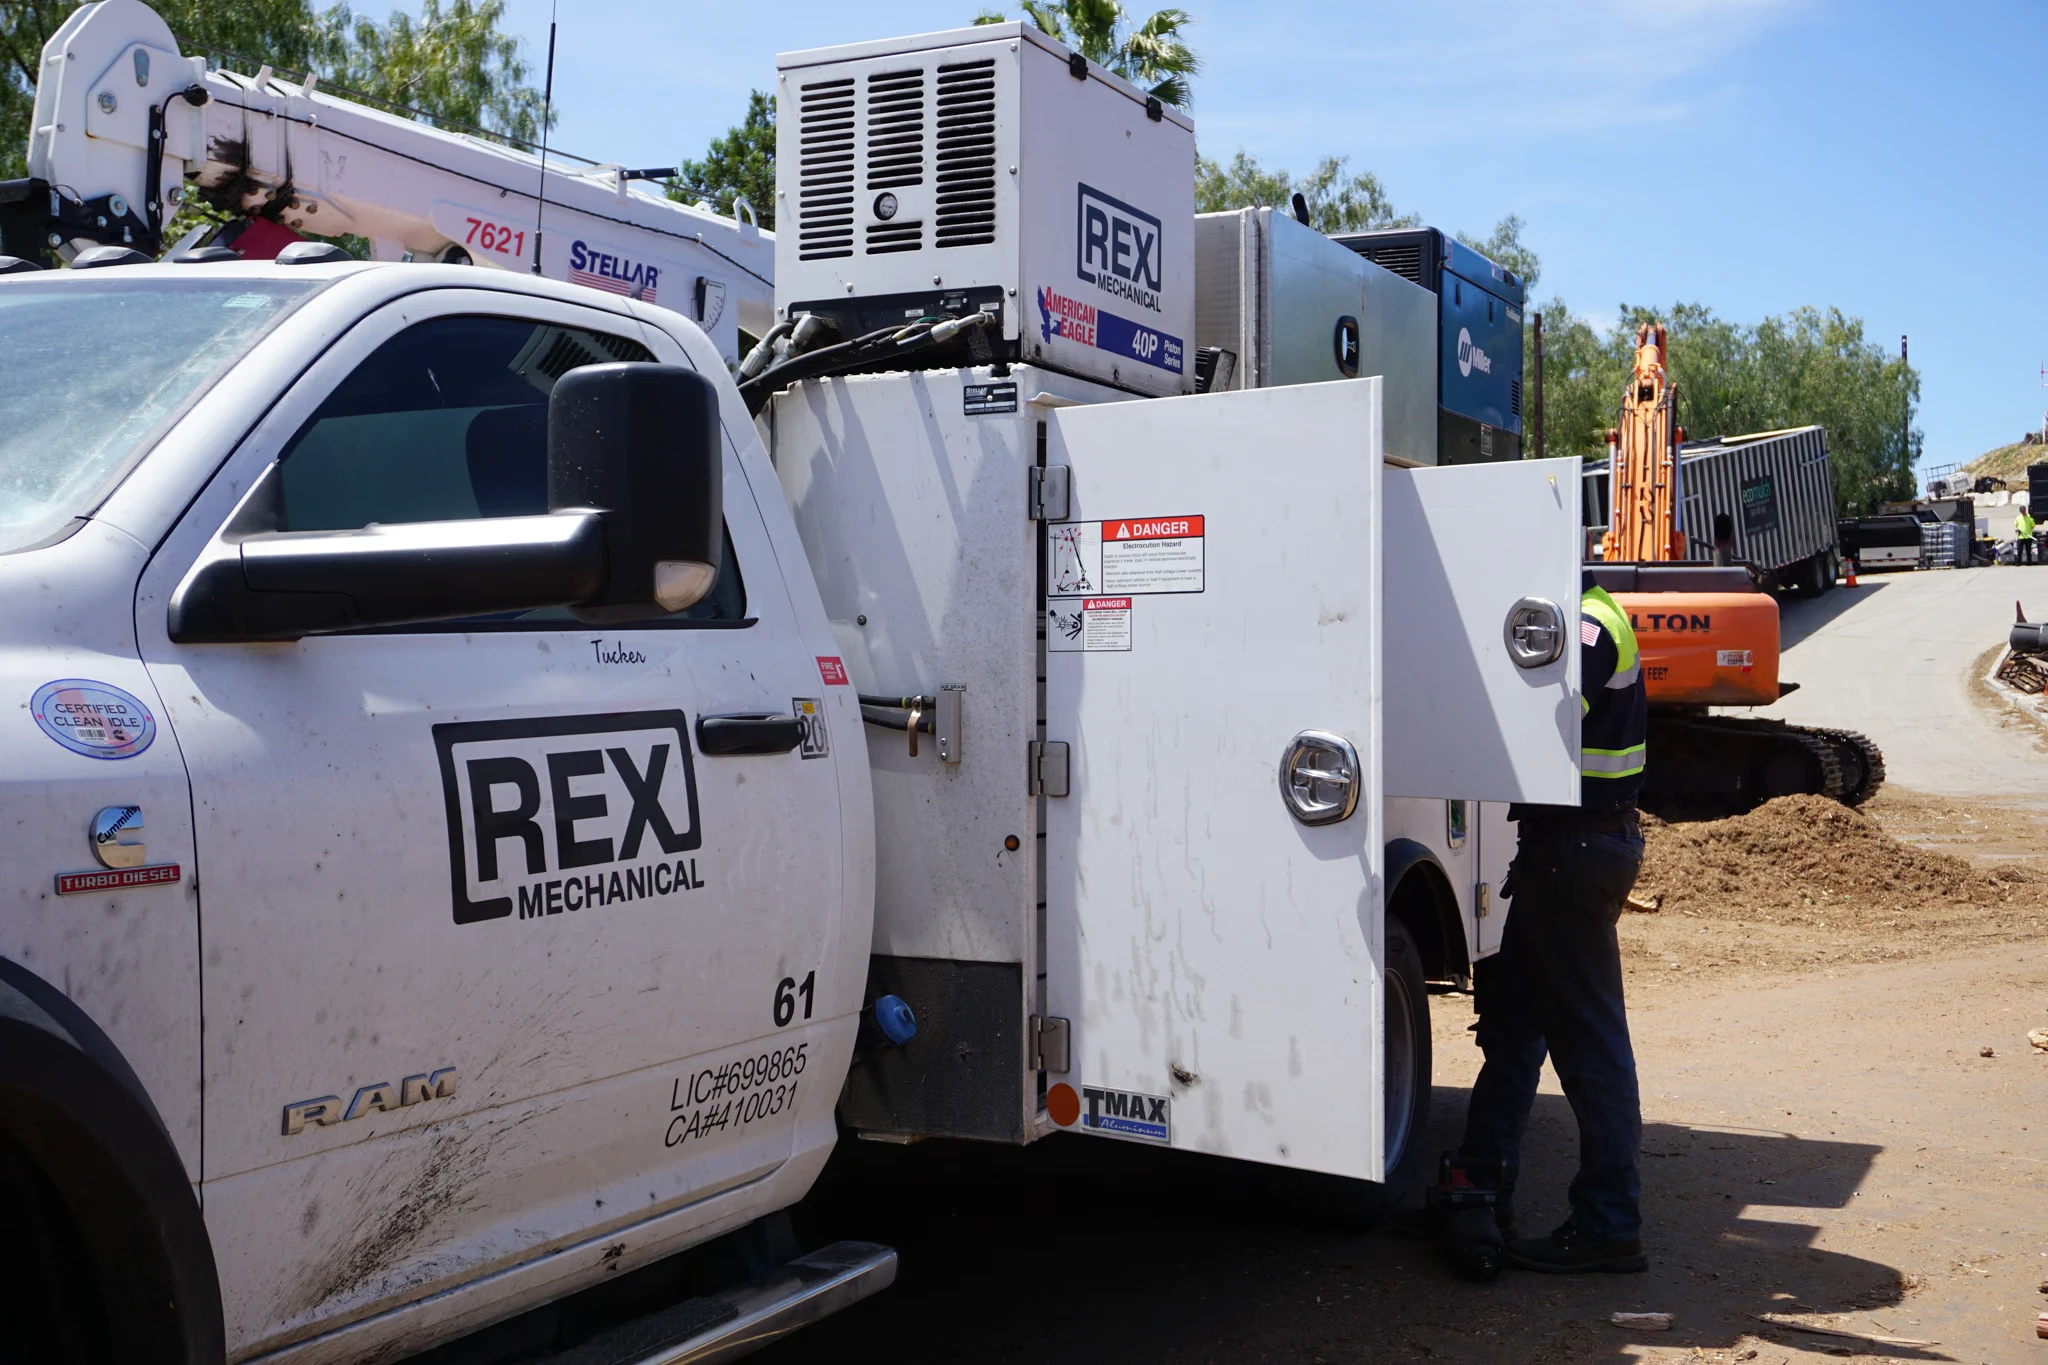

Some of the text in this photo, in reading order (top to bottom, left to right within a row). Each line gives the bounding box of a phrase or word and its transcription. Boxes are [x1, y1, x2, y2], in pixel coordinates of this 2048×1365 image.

[465, 217, 524, 257] 7621
[1085, 204, 1157, 290] REX
[570, 240, 659, 288] STELLAR
[1044, 286, 1095, 326] AMERICAN
[1097, 273, 1161, 312] MECHANICAL
[1060, 317, 1095, 347] EAGLE
[1132, 329, 1181, 359] 40P Piston
[1164, 353, 1181, 369] Series
[1473, 345, 1491, 374] Miller
[1133, 521, 1189, 536] DANGER
[1096, 600, 1126, 608] DANGER
[1632, 614, 1711, 632] LTON
[591, 639, 646, 664] Tucker
[820, 662, 834, 670] FIRE
[1647, 667, 1669, 680] FEET
[54, 716, 140, 728] CLEAN IDLE
[55, 703, 127, 714] CERTIFIED
[800, 715, 824, 752] 20
[97, 806, 141, 844] Cummins
[466, 744, 680, 883] REX
[63, 869, 178, 889] TURBO DIESEL
[518, 859, 705, 920] MECHANICAL
[773, 970, 815, 1028] 61
[670, 1043, 808, 1112] LIC#699865
[282, 1066, 457, 1136] RAM
[664, 1080, 798, 1148] CA#410031
[1083, 1087, 1166, 1128] TMAX
[1101, 1118, 1165, 1136] Aluminum
